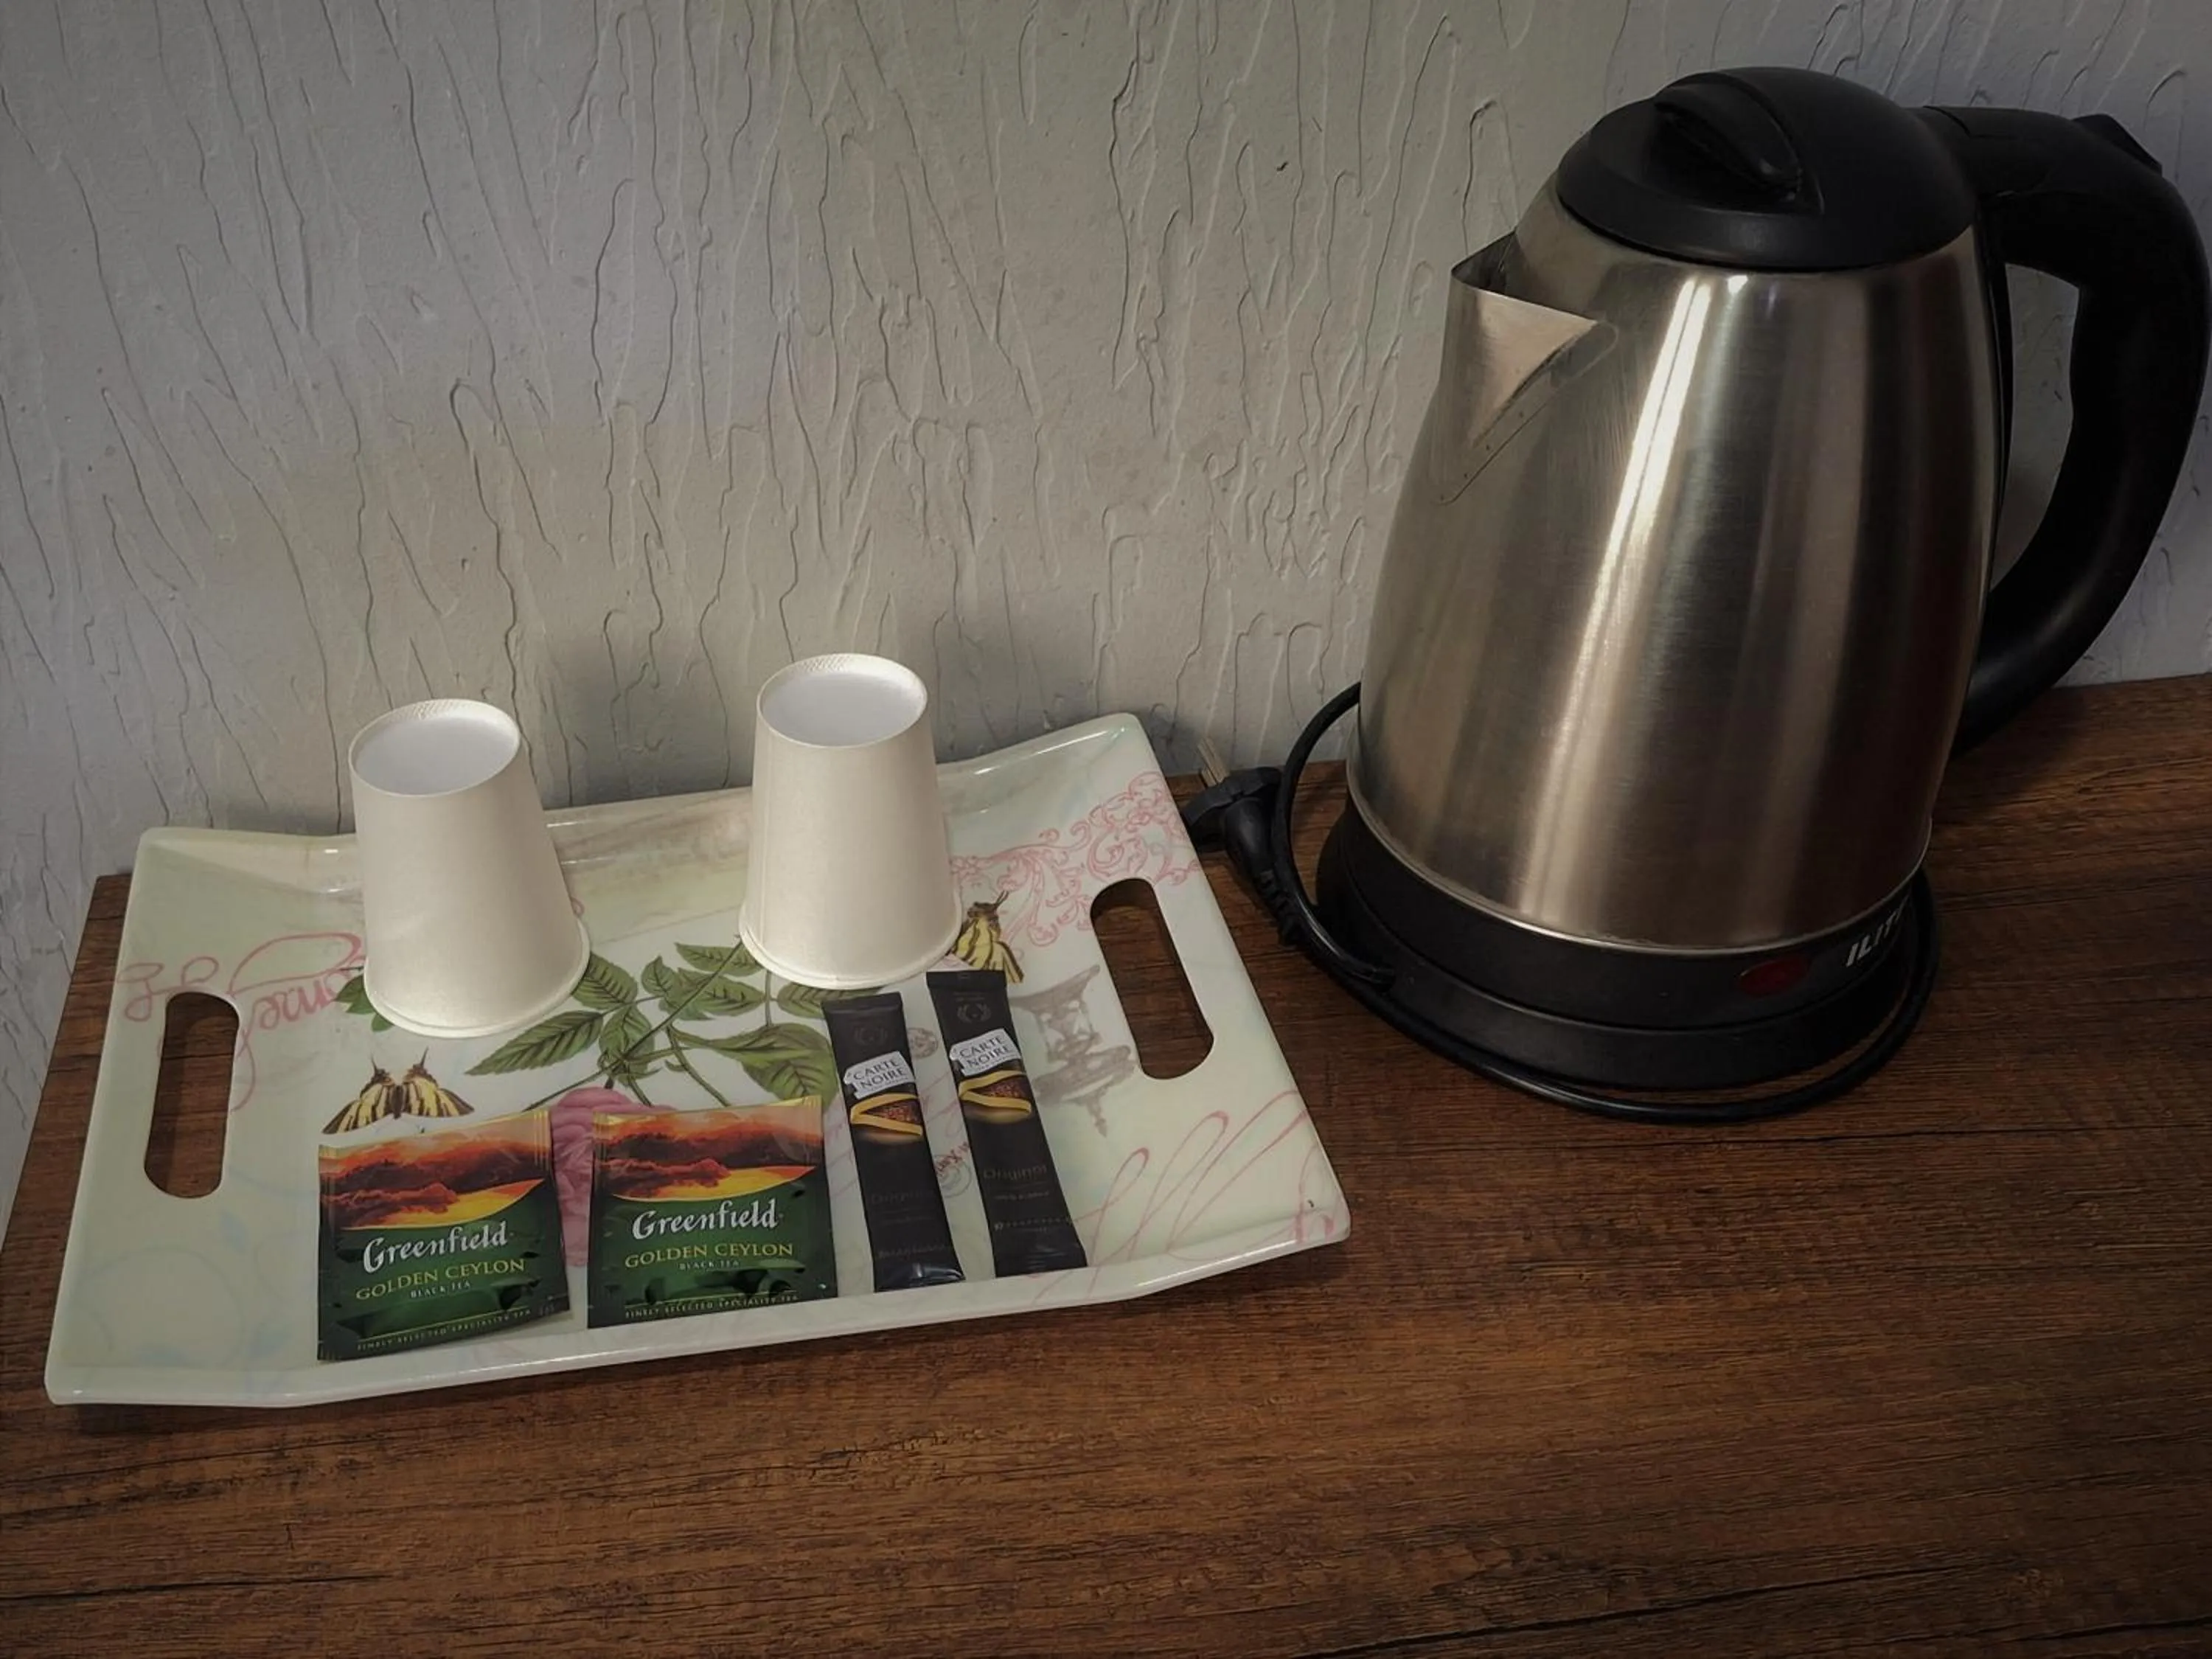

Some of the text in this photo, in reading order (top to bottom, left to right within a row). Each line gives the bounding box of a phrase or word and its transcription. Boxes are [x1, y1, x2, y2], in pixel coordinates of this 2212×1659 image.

[959, 1034, 1006, 1060] CARTE
[966, 1044, 1014, 1069] NOIRE
[852, 1057, 900, 1081] CARTE
[858, 1066, 908, 1091] NOIRE
[632, 1198, 778, 1240] Greenfield
[363, 1220, 509, 1274] Greenfield
[625, 1243, 793, 1268] GOLDEN CEYLON
[355, 1259, 526, 1300] GOLDEN CEYLON
